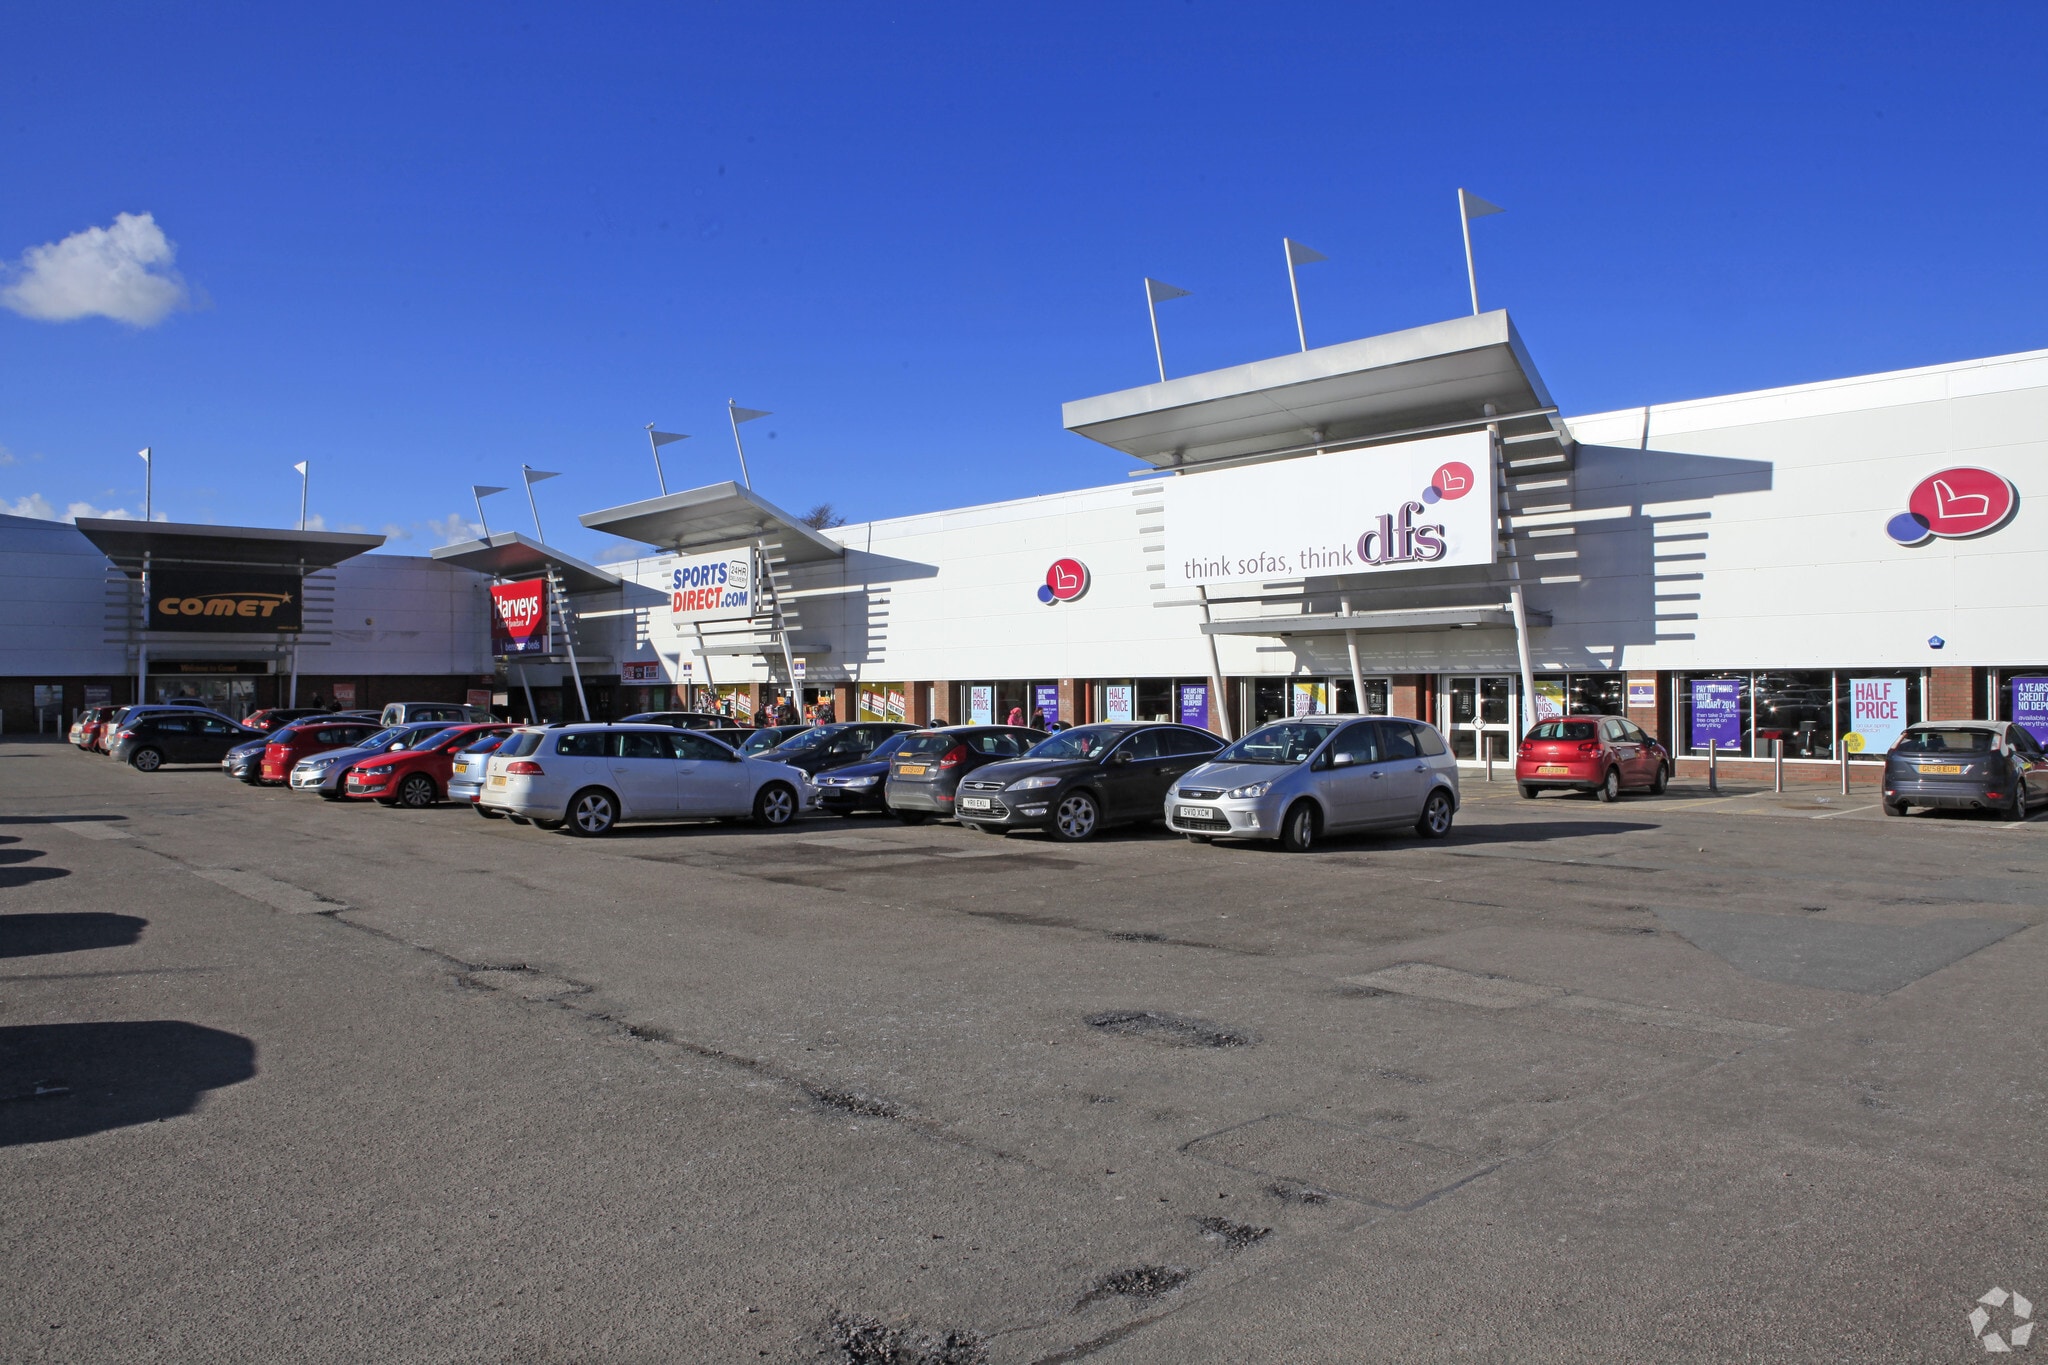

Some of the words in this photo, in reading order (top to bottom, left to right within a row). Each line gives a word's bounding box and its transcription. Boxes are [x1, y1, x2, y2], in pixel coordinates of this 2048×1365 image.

[1184, 555, 1231, 579] think
[1238, 551, 1292, 575] sofas,
[1299, 544, 1354, 570] think
[1357, 501, 1447, 566] dfs
[672, 562, 728, 590] SPORTS
[731, 565, 746, 576] 24HR
[158, 597, 280, 617] COMET
[494, 595, 539, 626] Harveys
[973, 688, 986, 699] HALF
[1109, 688, 1125, 699] HALF
[1707, 684, 1732, 692] NOTHING
[1856, 683, 1892, 700] HALF
[2018, 684, 2023, 692] 4
[2018, 692, 2046, 701] CREDIT
[973, 700, 988, 710] PRICE
[1110, 700, 1128, 712] PRICE
[1696, 700, 1720, 708] JANUARY
[1722, 700, 1736, 708] 2014
[2018, 702, 2029, 710] NO
[1856, 701, 1898, 719] PRICE
[1197, 809, 1210, 817] XCM
